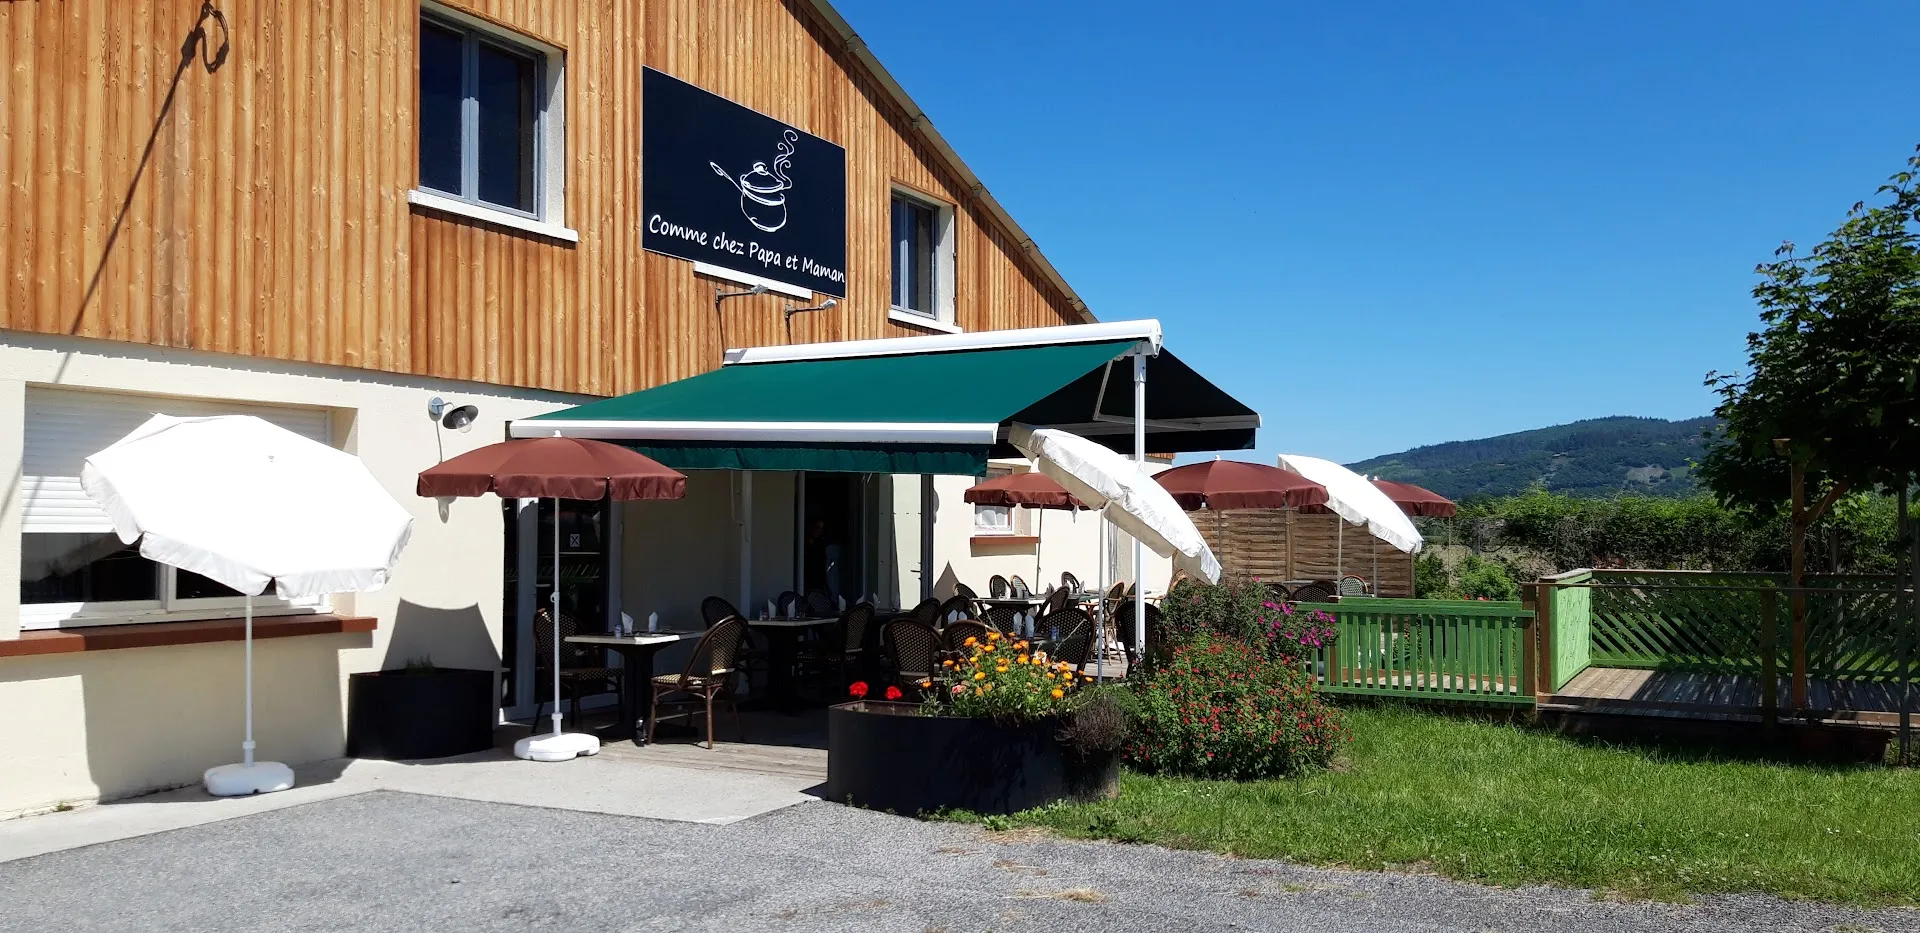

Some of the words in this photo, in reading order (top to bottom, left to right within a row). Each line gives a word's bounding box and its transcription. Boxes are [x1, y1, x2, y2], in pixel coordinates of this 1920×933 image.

[649, 214, 708, 246] Comme
[713, 232, 744, 256] chez
[749, 242, 781, 268] Papa
[785, 254, 799, 271] et
[802, 257, 845, 284] Maman
